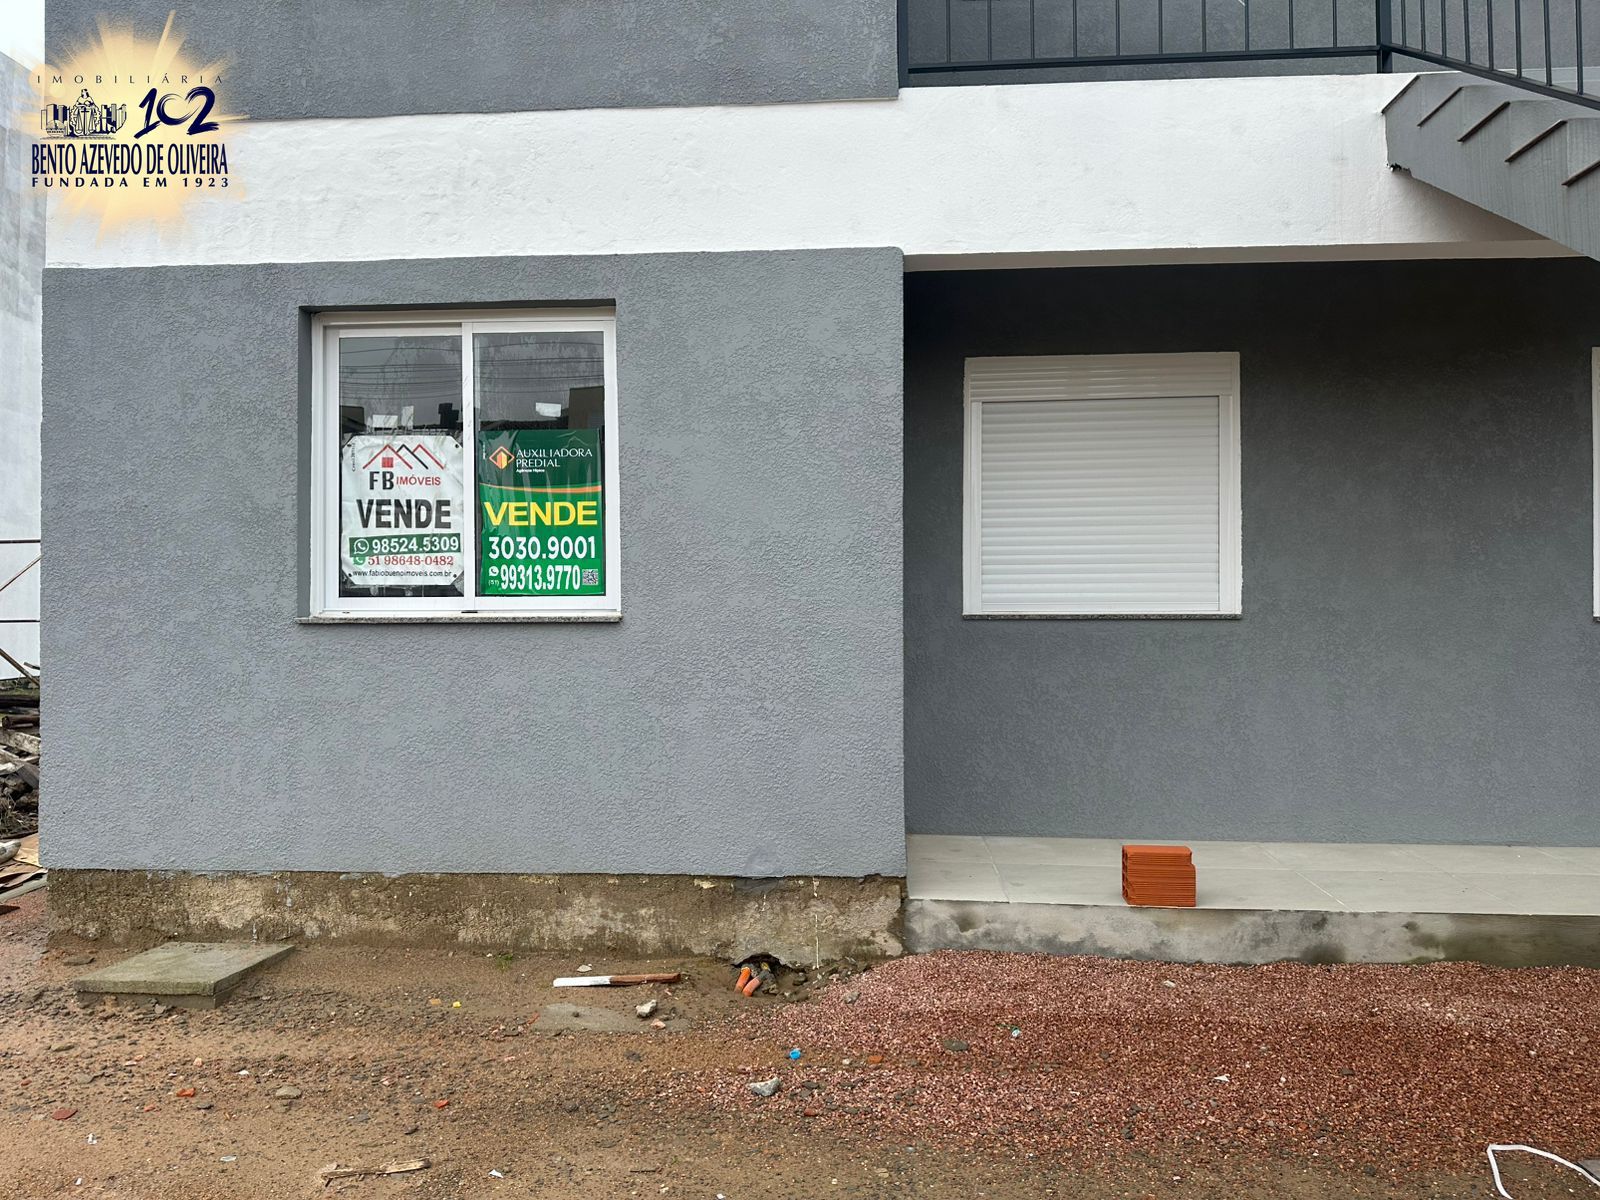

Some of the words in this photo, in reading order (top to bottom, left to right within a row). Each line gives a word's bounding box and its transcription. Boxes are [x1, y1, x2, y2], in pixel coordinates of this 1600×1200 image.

[516, 447, 593, 458] AUXILIADORA
[516, 458, 560, 468] PREDIAL
[369, 470, 395, 490] FB
[396, 474, 441, 486] IMÓVEIS
[356, 499, 452, 529] VENDE
[483, 501, 598, 526] VENDE
[372, 536, 459, 554] 98524.5309
[488, 536, 596, 560] 3030.9001
[384, 555, 454, 566] 98648-0482
[500, 564, 581, 591] 99313.9770
